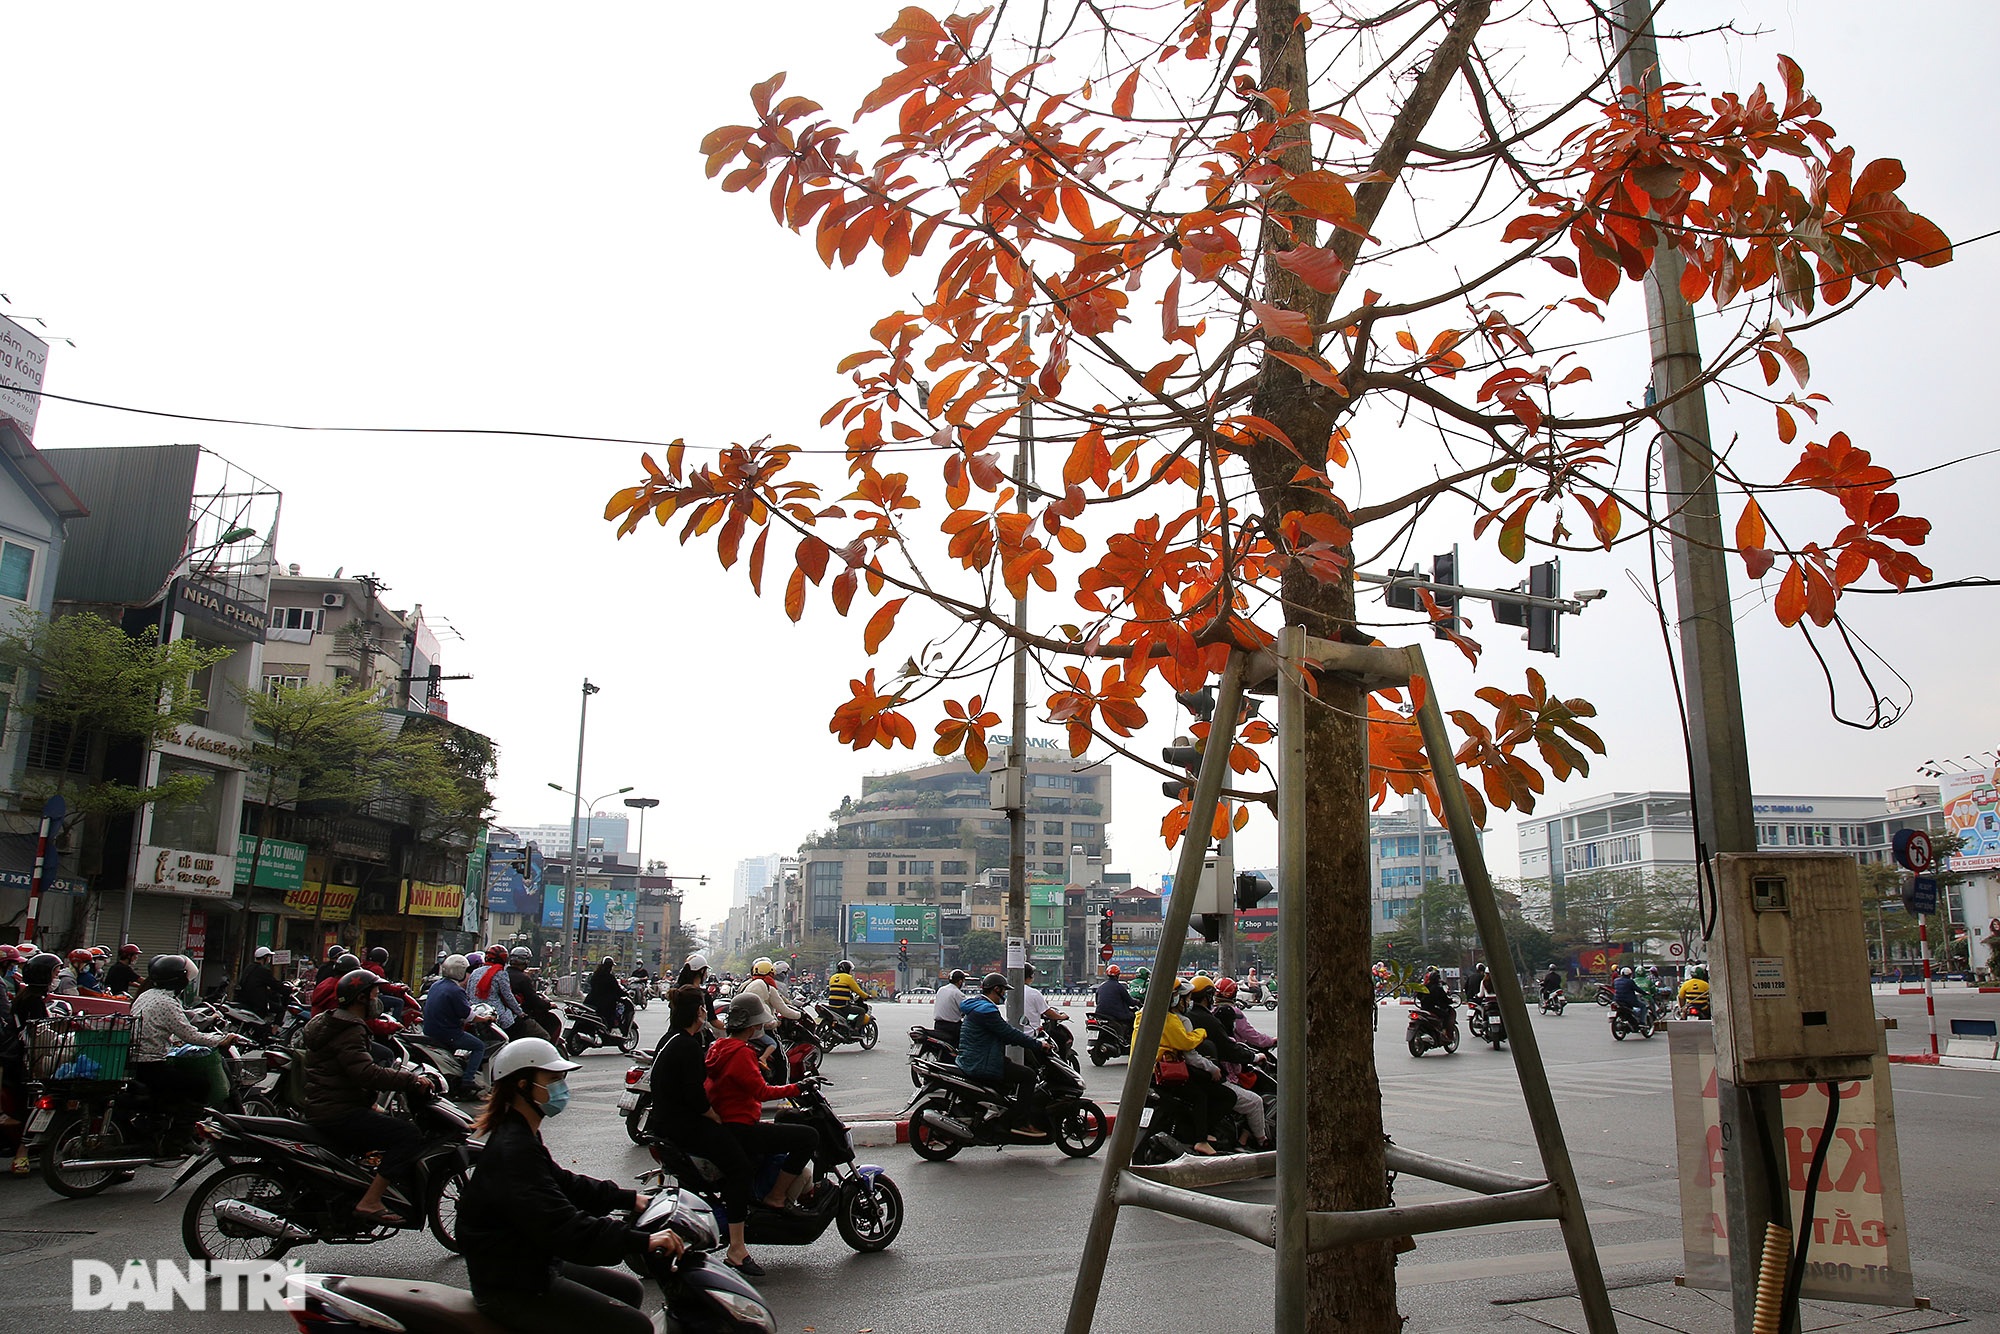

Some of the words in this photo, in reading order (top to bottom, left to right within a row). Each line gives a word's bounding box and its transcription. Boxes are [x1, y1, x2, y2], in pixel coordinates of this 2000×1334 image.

[14, 357, 42, 385] Kông
[183, 586, 219, 612] NHA
[223, 603, 265, 630] PHAN
[195, 858, 214, 871] ANH
[289, 889, 320, 906] HOA
